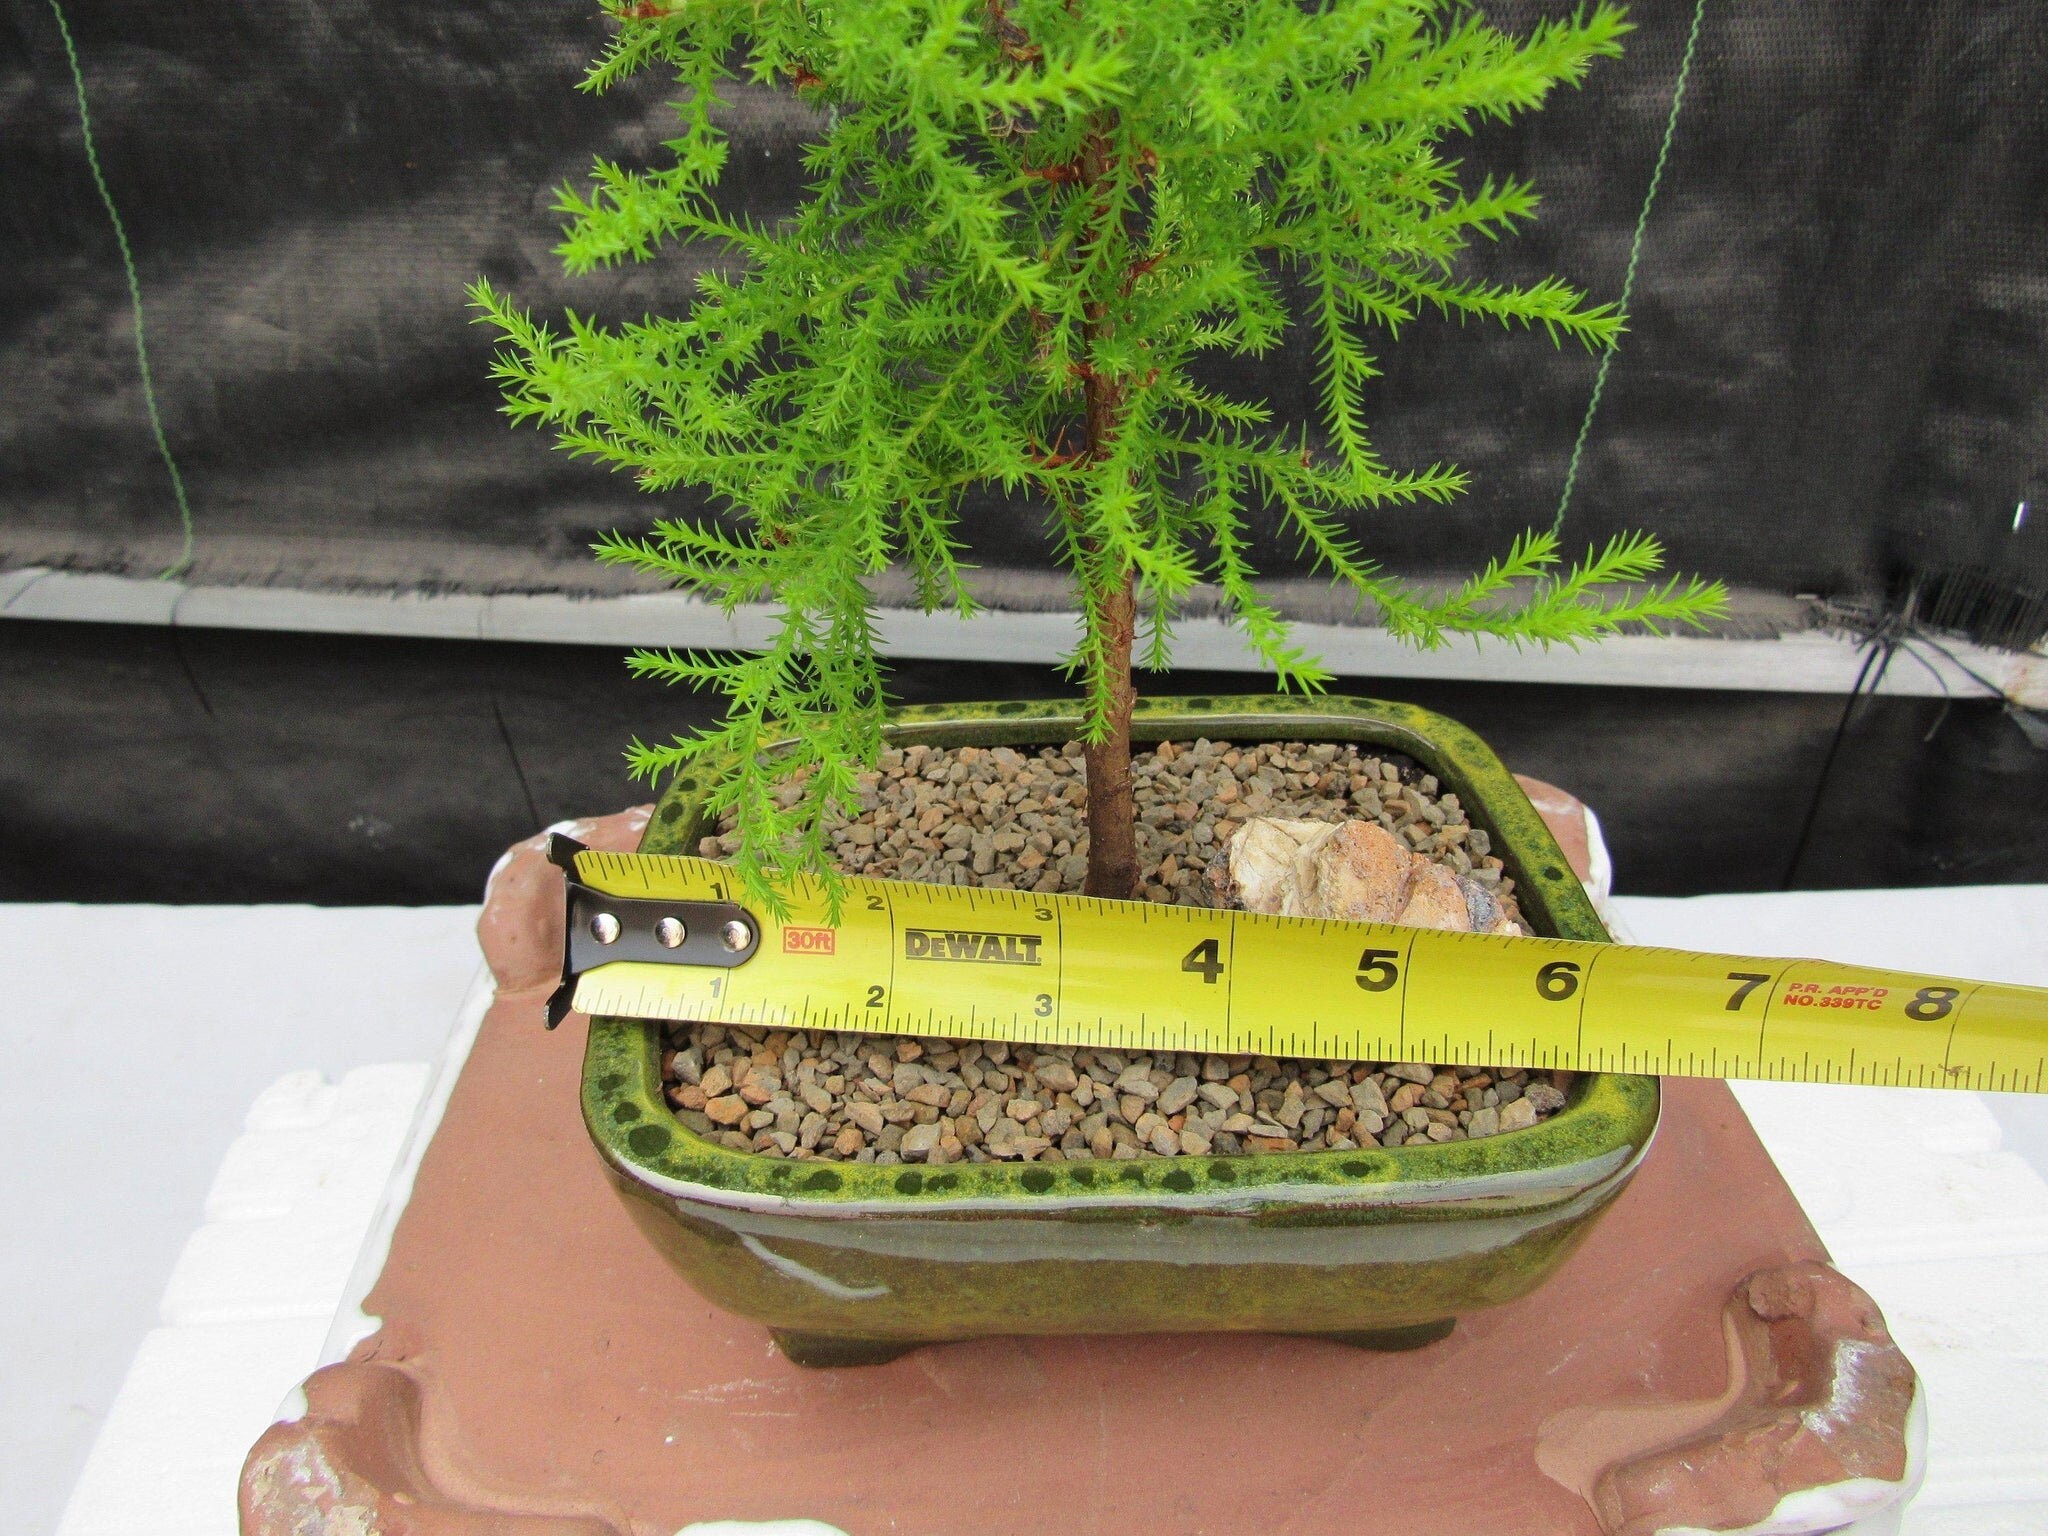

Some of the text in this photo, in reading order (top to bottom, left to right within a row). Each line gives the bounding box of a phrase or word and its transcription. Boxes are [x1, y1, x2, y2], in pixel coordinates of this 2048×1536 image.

[710, 883, 723, 900] 1
[866, 895, 885, 911] 2
[1035, 908, 1053, 921] 3
[787, 930, 832, 951] 30ft
[1181, 939, 1224, 984] 4
[1355, 949, 1399, 992] 5
[710, 977, 722, 998] 1
[1535, 962, 1580, 1001] 6
[1725, 972, 1771, 1011] 7
[1788, 983, 1889, 998] P.R. APP'D
[866, 985, 885, 1007] 2
[1034, 994, 1052, 1017] 3
[1904, 987, 1960, 1021] 8
